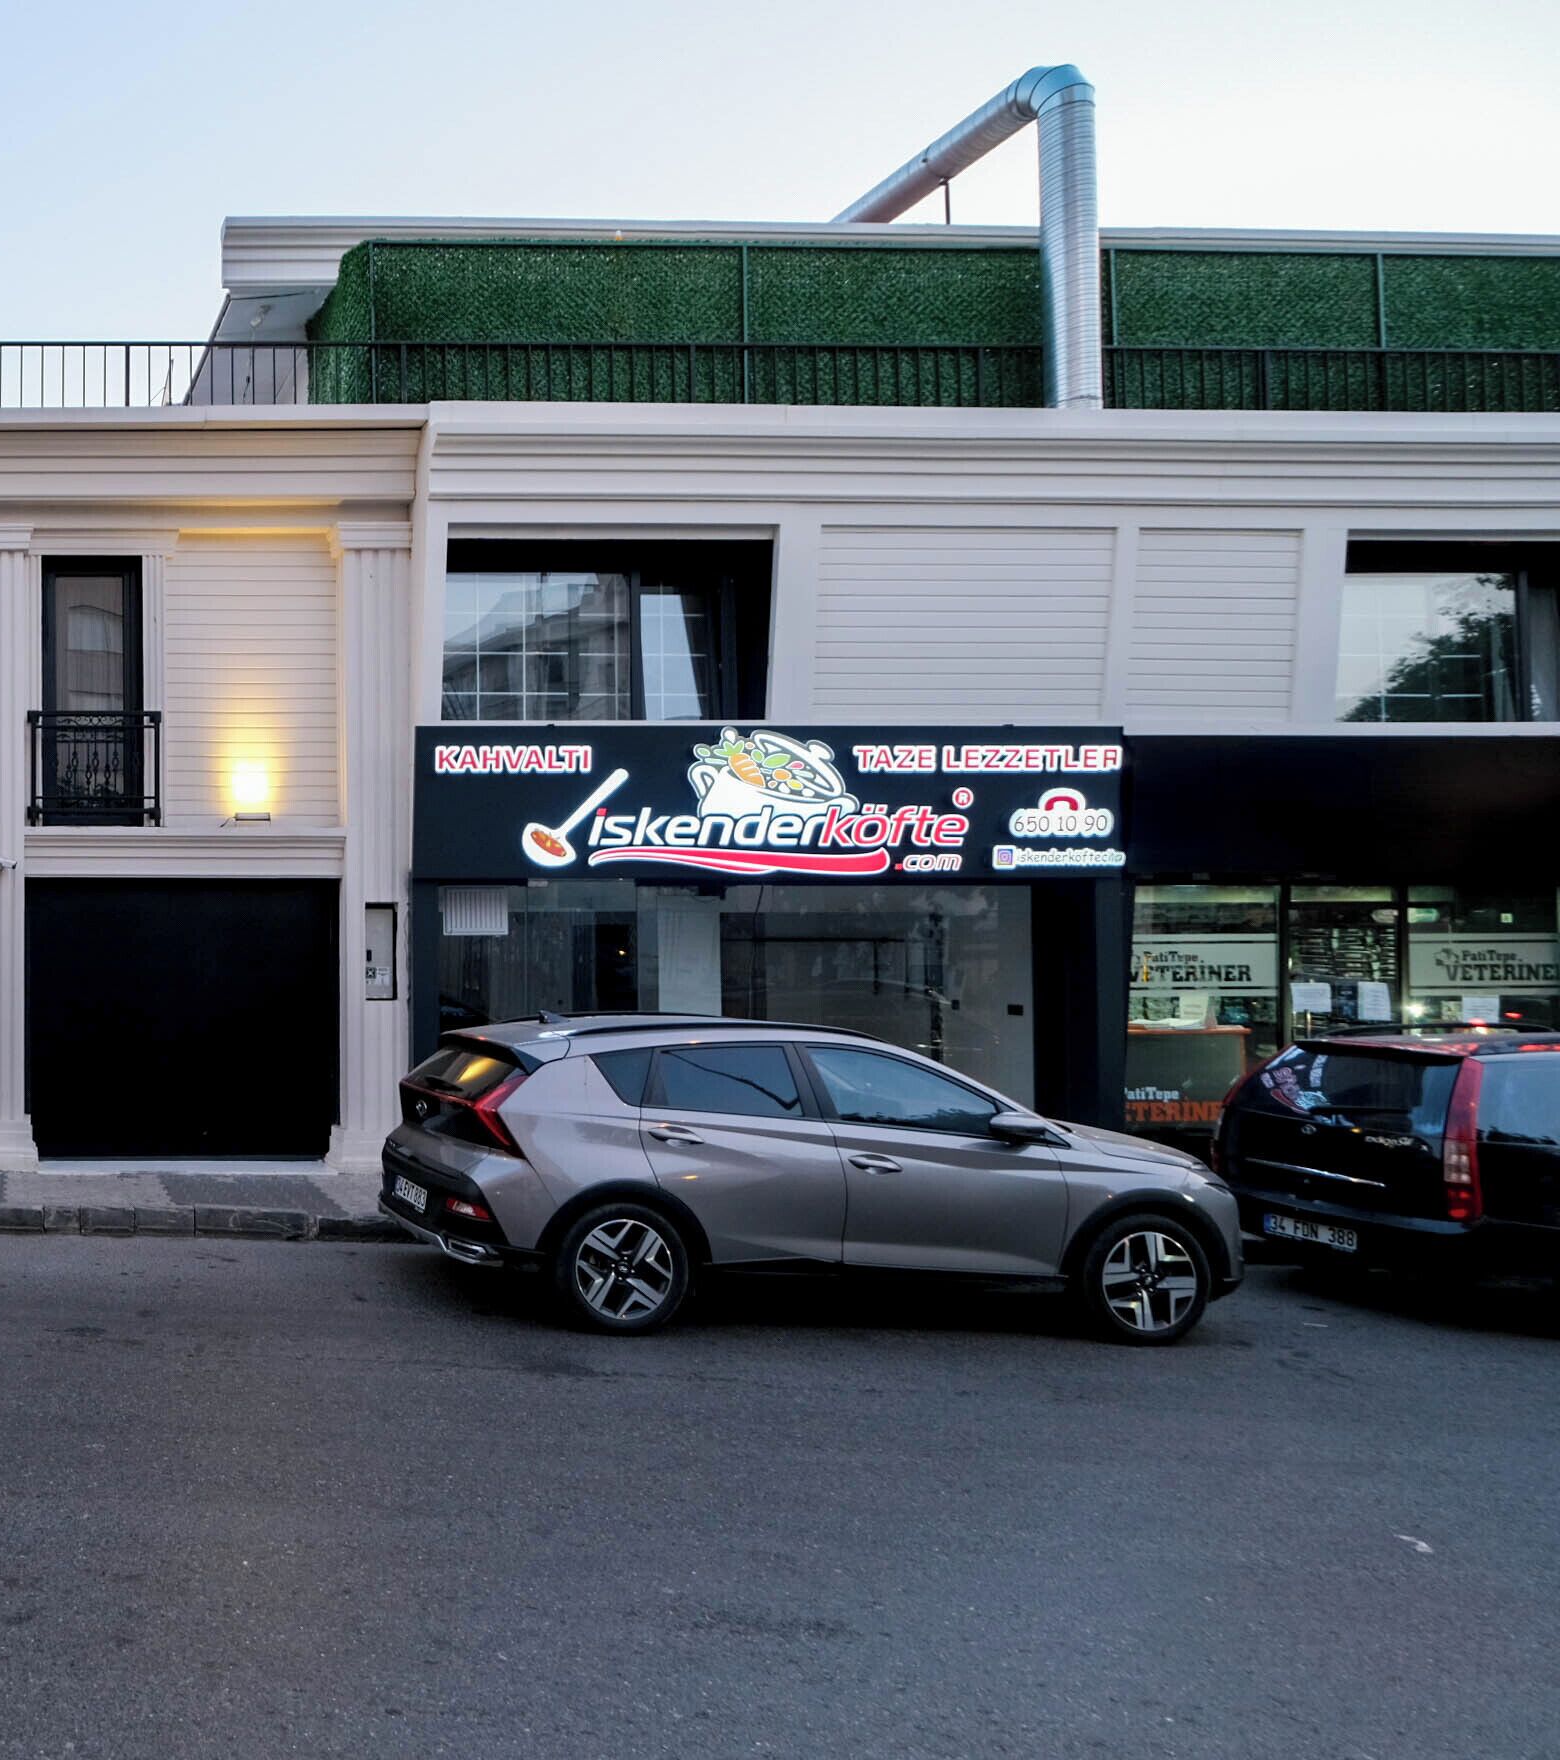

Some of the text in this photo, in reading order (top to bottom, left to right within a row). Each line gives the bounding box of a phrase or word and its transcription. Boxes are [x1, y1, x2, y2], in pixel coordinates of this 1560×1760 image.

[436, 746, 591, 771] KAHVALTI
[855, 748, 1121, 770] TAZE LEZZETLER
[1014, 815, 1108, 832] 650 10 90
[1270, 1215, 1285, 1231] 34
[1328, 1227, 1354, 1247] 388
